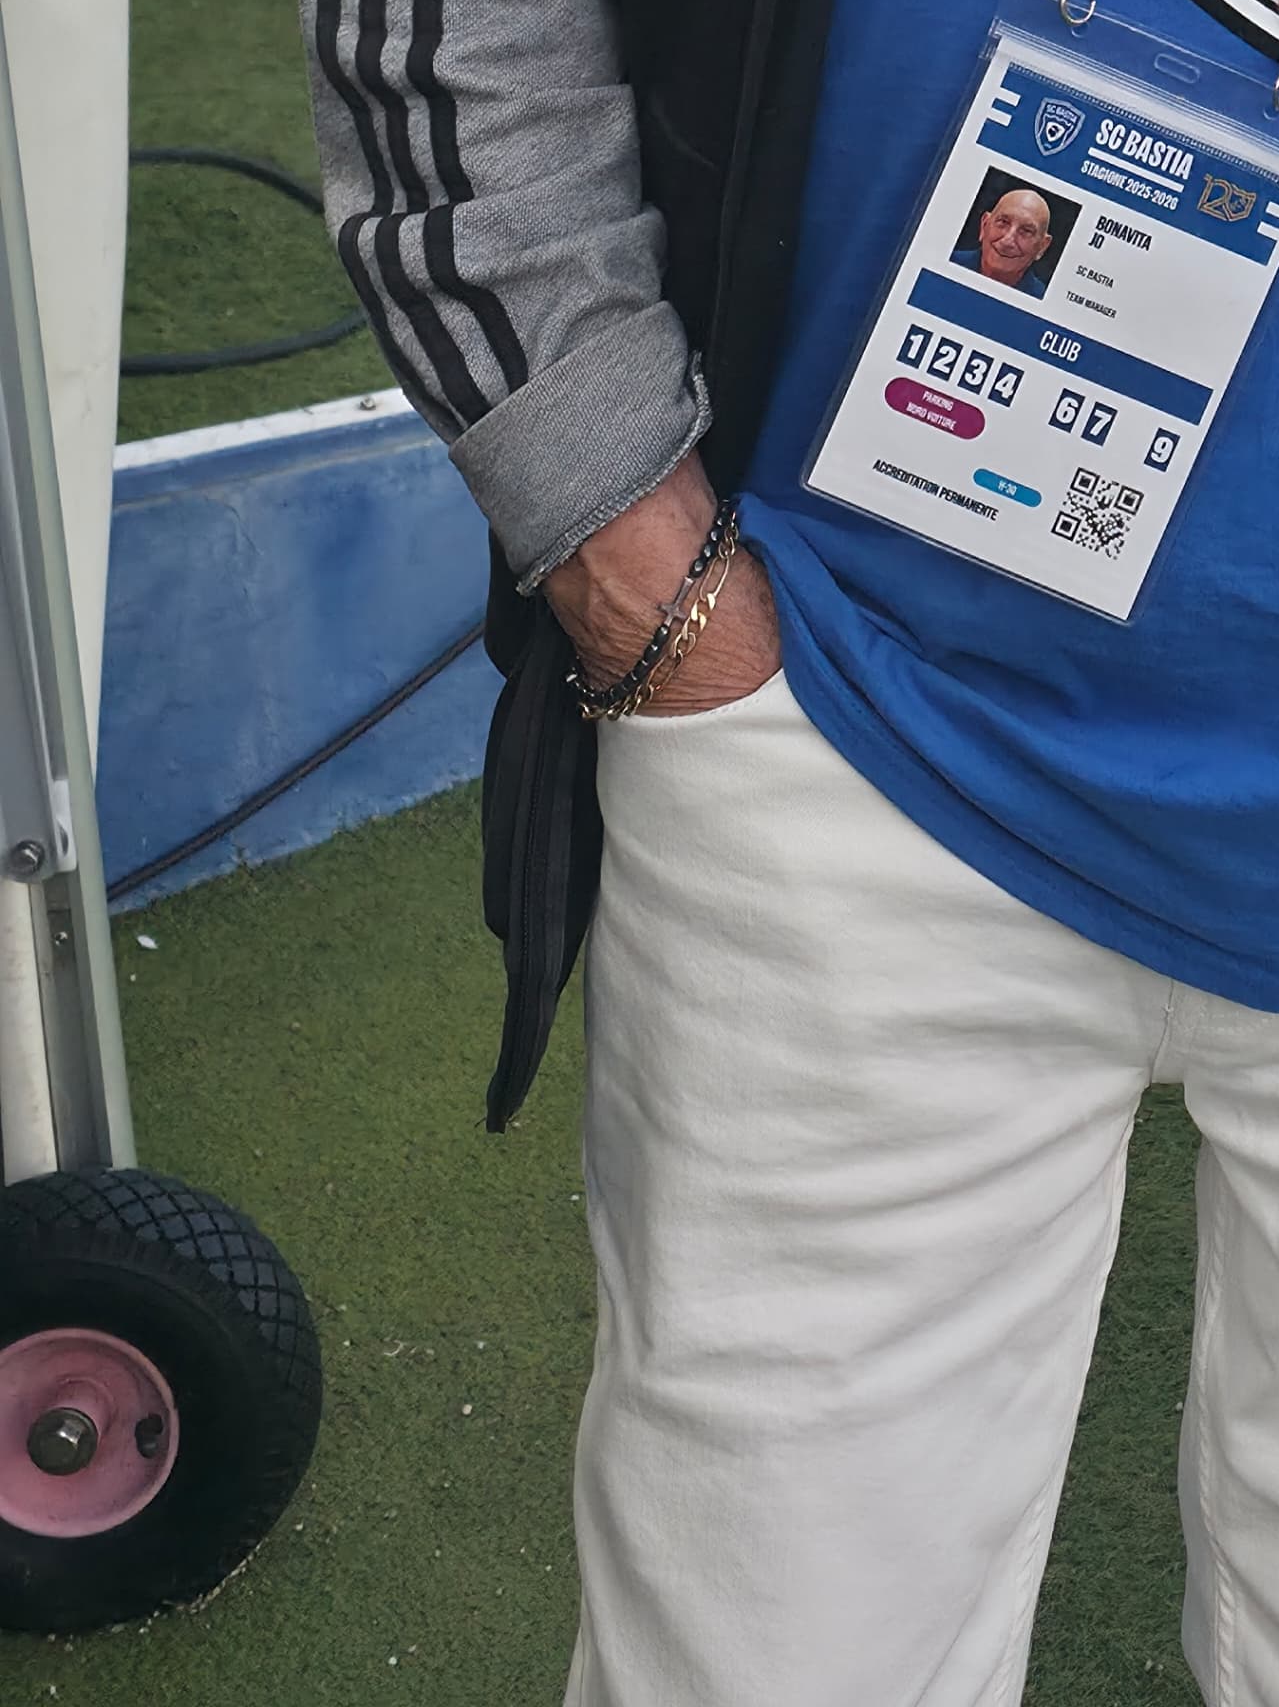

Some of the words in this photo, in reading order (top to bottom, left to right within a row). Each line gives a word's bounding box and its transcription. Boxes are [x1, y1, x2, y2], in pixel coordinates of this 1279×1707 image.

[1096, 119, 1126, 150] SC
[1122, 130, 1194, 180] BASTIA
[1081, 160, 1127, 189] STAGIONE
[1125, 179, 1179, 210] 2025-2026
[1088, 233, 1105, 250] JO
[1095, 215, 1152, 251] BONAVITA
[1076, 265, 1088, 277] SC
[1086, 269, 1114, 288] BASTIA
[1039, 330, 1082, 363] CLUB
[906, 334, 925, 360] 1
[932, 345, 956, 374] 2
[964, 358, 987, 386] 3
[995, 372, 1018, 400] 4
[1055, 396, 1079, 424] 6
[1088, 409, 1112, 437] 7
[1151, 436, 1175, 464] 9
[872, 459, 941, 496] ACCREDITATION
[938, 487, 999, 521] PERMANENTE
